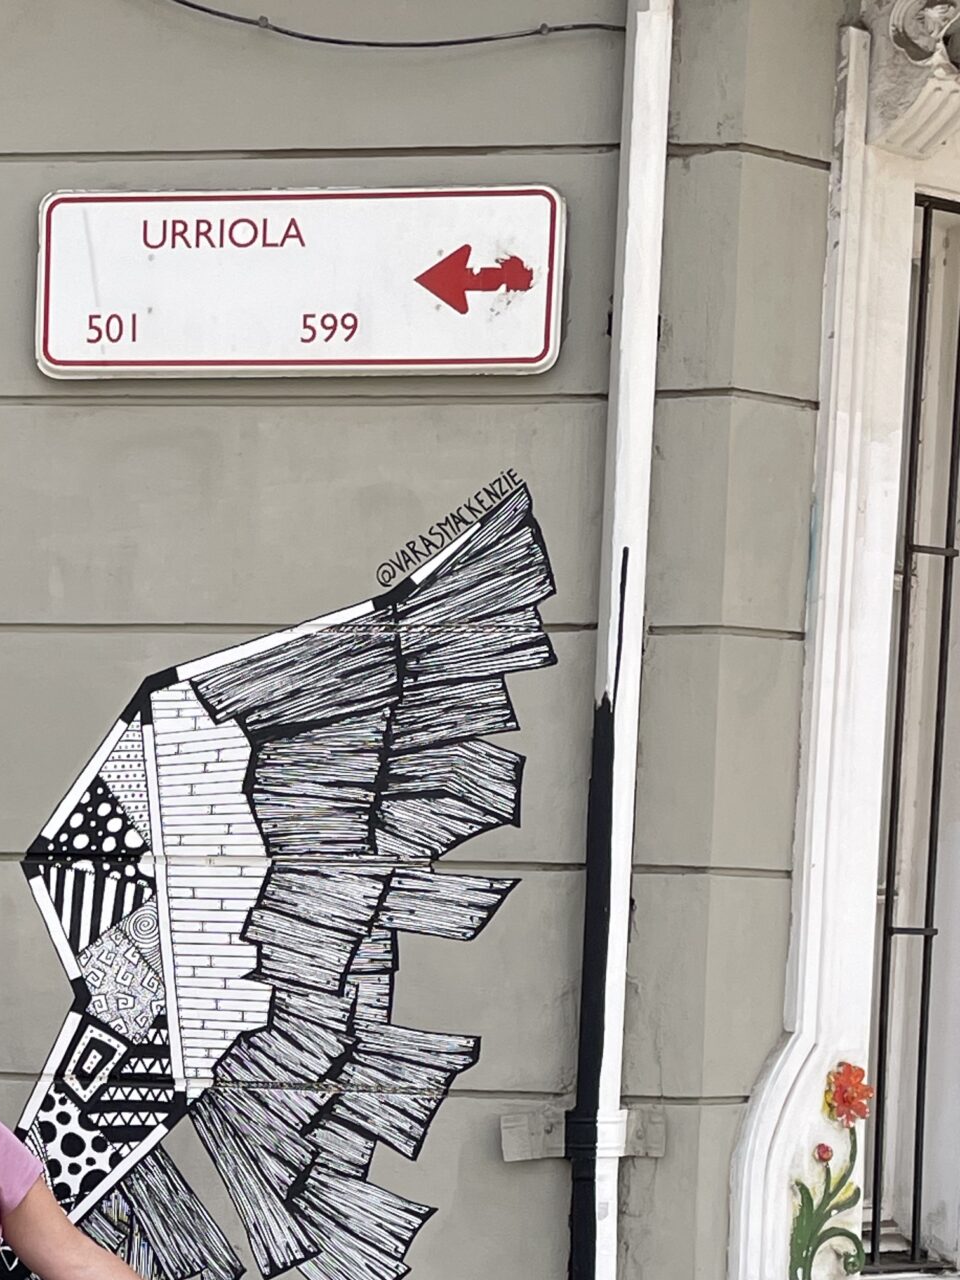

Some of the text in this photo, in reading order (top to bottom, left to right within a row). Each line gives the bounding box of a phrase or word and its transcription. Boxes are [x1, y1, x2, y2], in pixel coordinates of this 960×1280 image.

[142, 218, 306, 249] URRIOLA
[86, 312, 359, 344] 501 599
[376, 468, 523, 587] @VARASMACKENZIE
